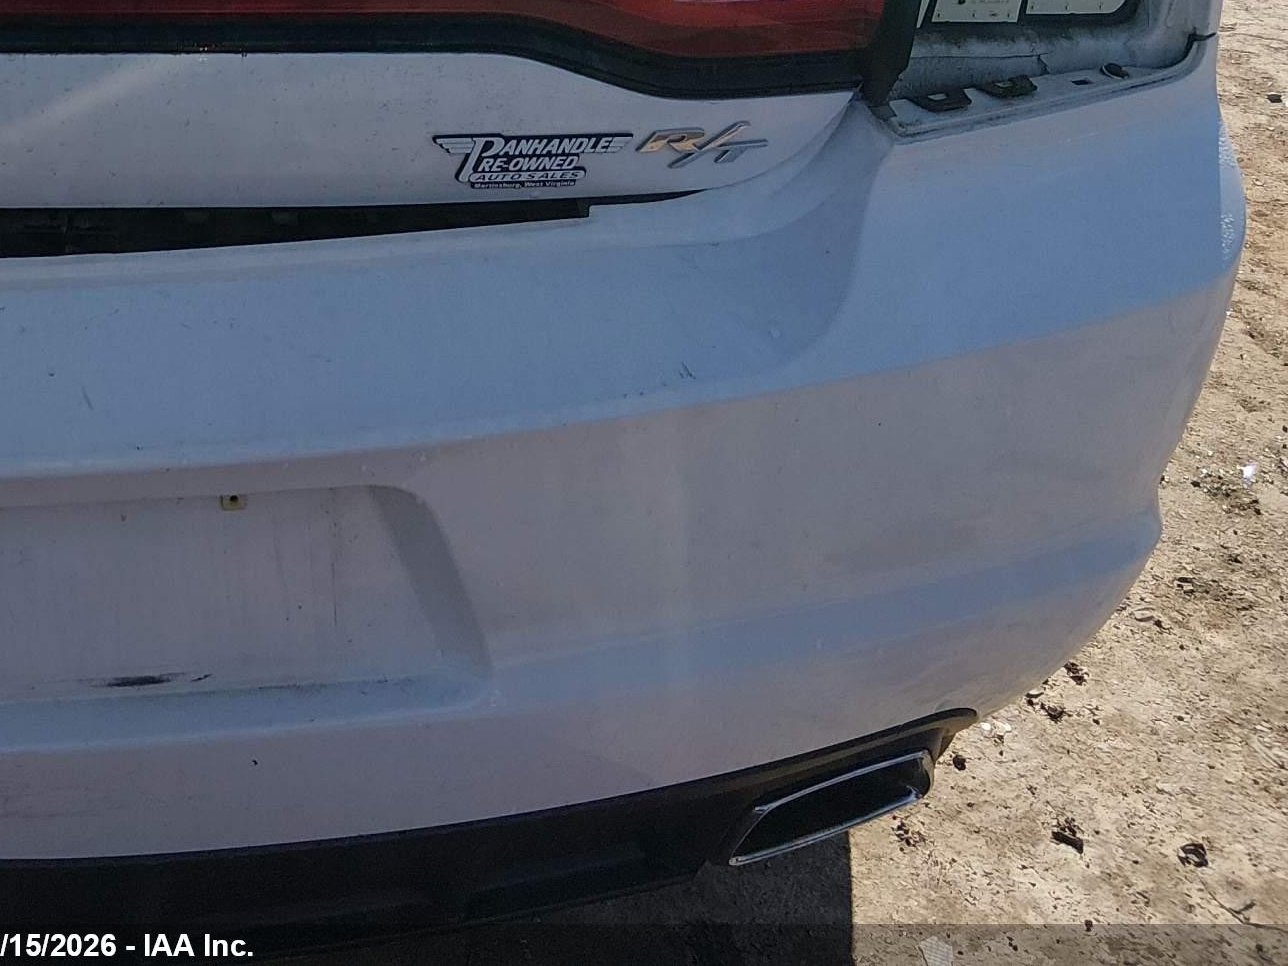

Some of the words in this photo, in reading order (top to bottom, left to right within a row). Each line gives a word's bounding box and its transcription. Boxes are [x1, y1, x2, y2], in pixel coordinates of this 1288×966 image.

[635, 120, 768, 169] R/T
[475, 173, 522, 181] AUTO
[526, 171, 580, 180] SALES
